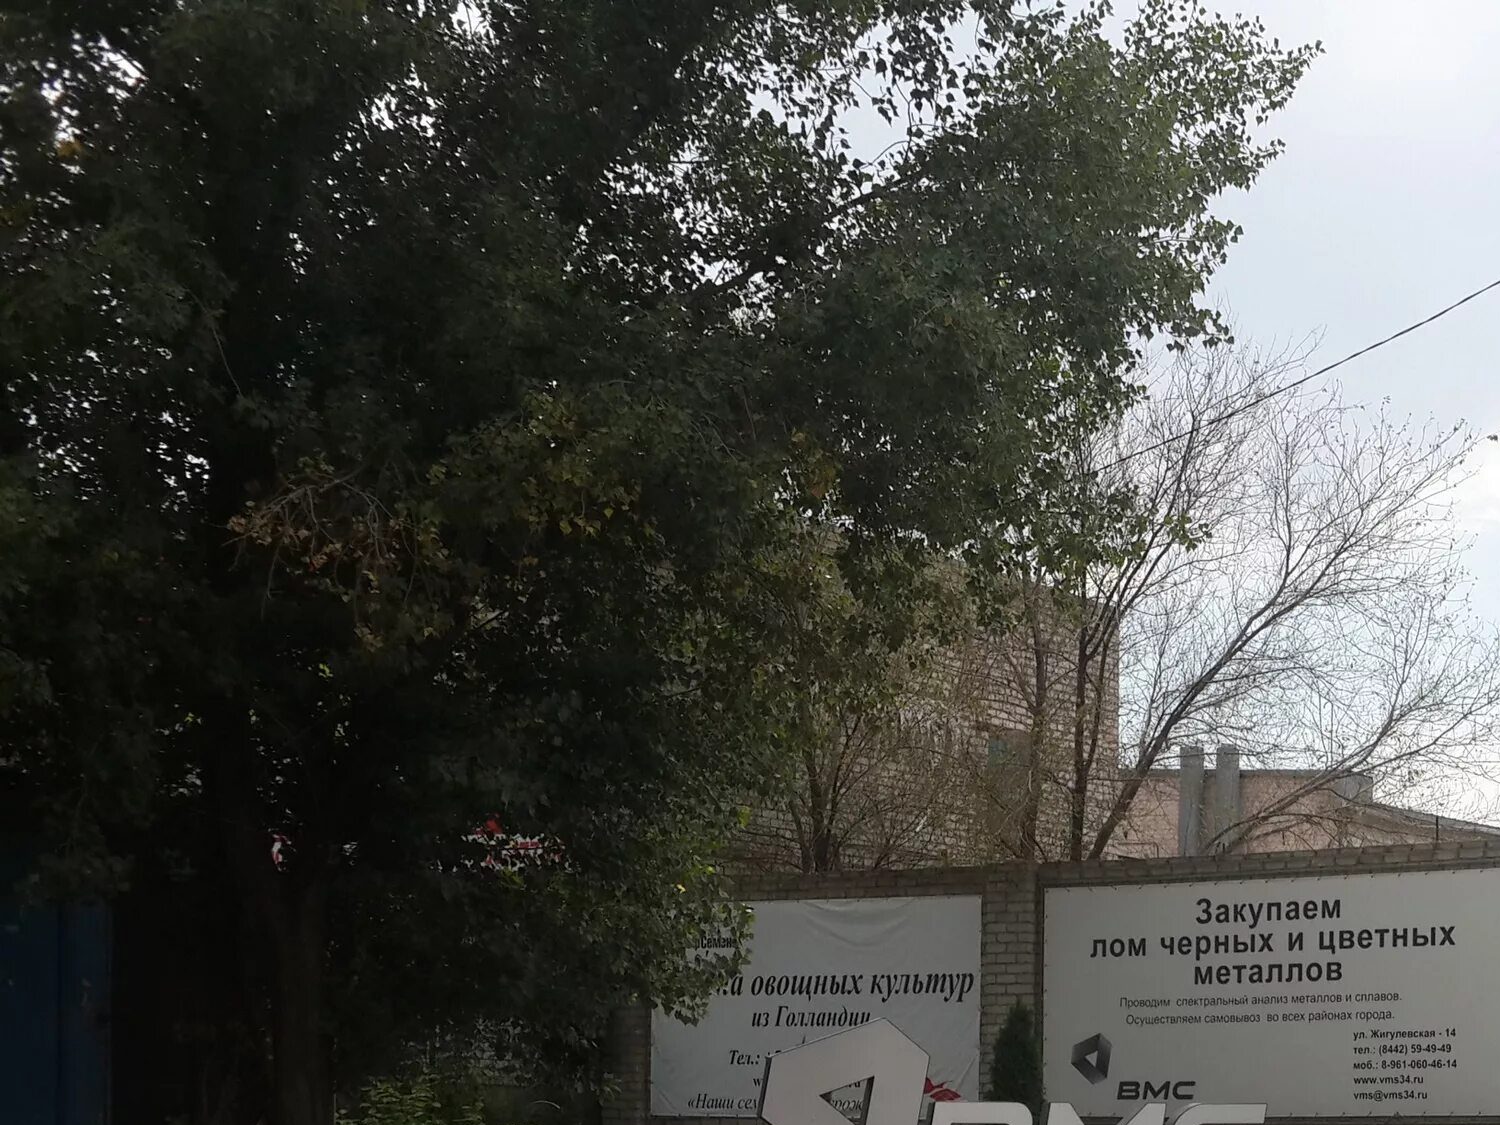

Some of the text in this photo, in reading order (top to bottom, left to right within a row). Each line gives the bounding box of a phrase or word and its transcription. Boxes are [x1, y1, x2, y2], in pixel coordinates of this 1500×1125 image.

[1196, 897, 1342, 928] Закупаем
[1091, 926, 1456, 961] лом черных и цветных
[1195, 960, 1343, 985] металлов
[751, 974, 864, 1001] овощных
[870, 969, 975, 1003] культур
[1120, 992, 1403, 1009] Проводим спектральный анализ металлов и сплавов.
[752, 1005, 872, 1028] из Голландии
[1126, 1010, 1395, 1026] Осуществляем самовывоз во всех районах города.
[1353, 1031, 1367, 1040] ул.
[1370, 1028, 1436, 1041] Жигулевская
[1446, 1028, 1457, 1038] 14
[730, 1050, 760, 1066] Тел.:
[1353, 1043, 1452, 1056] тел.: (8442) 59-49-49
[1353, 1058, 1458, 1070] моб.: 8-961-060-46-14
[1353, 1075, 1425, 1086] www.vms34.ru
[1117, 1080, 1197, 1100] ВМС
[1353, 1090, 1428, 1102] vms@vms34.ru
[688, 1093, 734, 1110] «Наши
